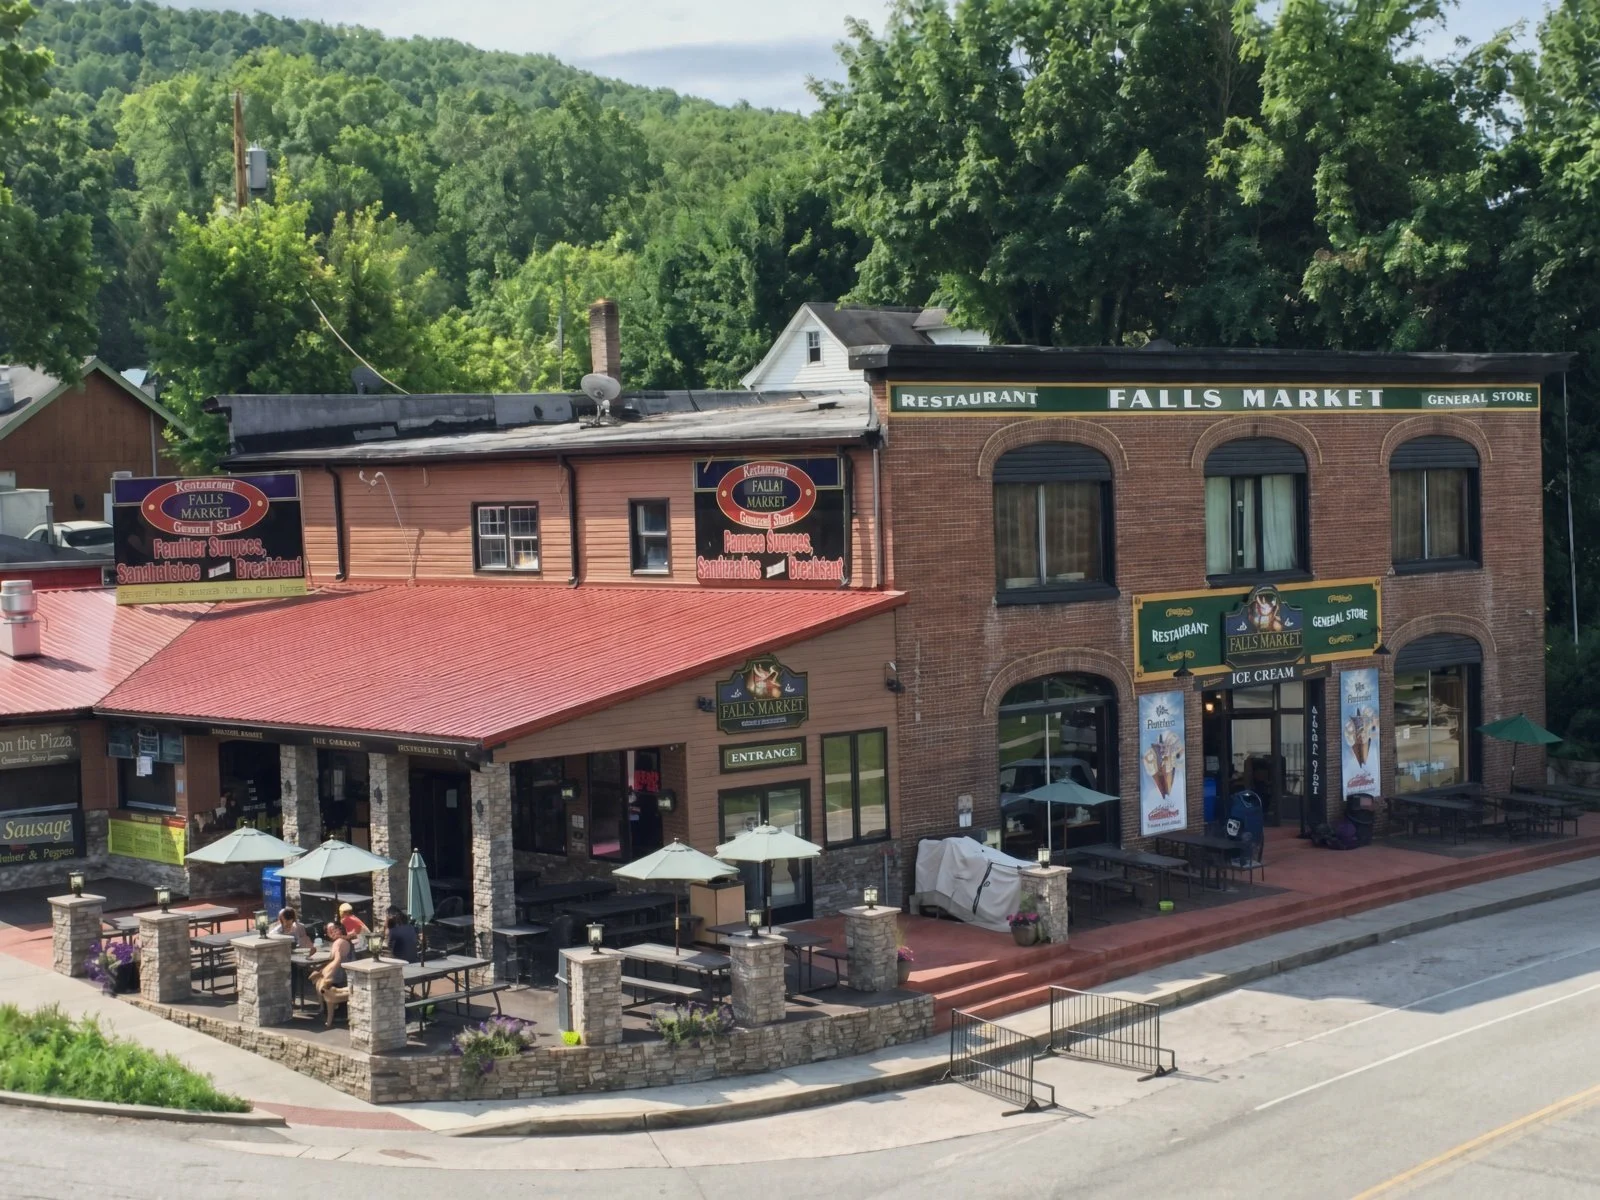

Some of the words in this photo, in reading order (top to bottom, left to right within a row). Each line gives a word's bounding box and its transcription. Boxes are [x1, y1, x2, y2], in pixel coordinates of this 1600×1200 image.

[900, 390, 1038, 408] RESTAURANT
[1109, 388, 1223, 408] FALLS
[1243, 388, 1384, 408] MARKET
[1427, 393, 1488, 406] GENERAL
[1492, 390, 1533, 402] STORE
[188, 493, 223, 505] FALLS
[746, 496, 787, 508] MARKET
[181, 507, 231, 519] MARKET
[1312, 614, 1345, 629] GENERAL
[1345, 607, 1369, 622] STORE
[1151, 622, 1210, 643] RESTAURANT
[1230, 636, 1259, 652] FALLS
[1260, 631, 1301, 649] MARKET
[1232, 671, 1252, 685] ICE
[1254, 666, 1295, 682] CREAM
[722, 702, 755, 719] FALLS
[757, 697, 805, 715] MARKET
[17, 735, 37, 751] the
[39, 732, 73, 749] Pizza
[731, 747, 797, 763] ENTRANCE
[2, 819, 72, 841] Sausage
